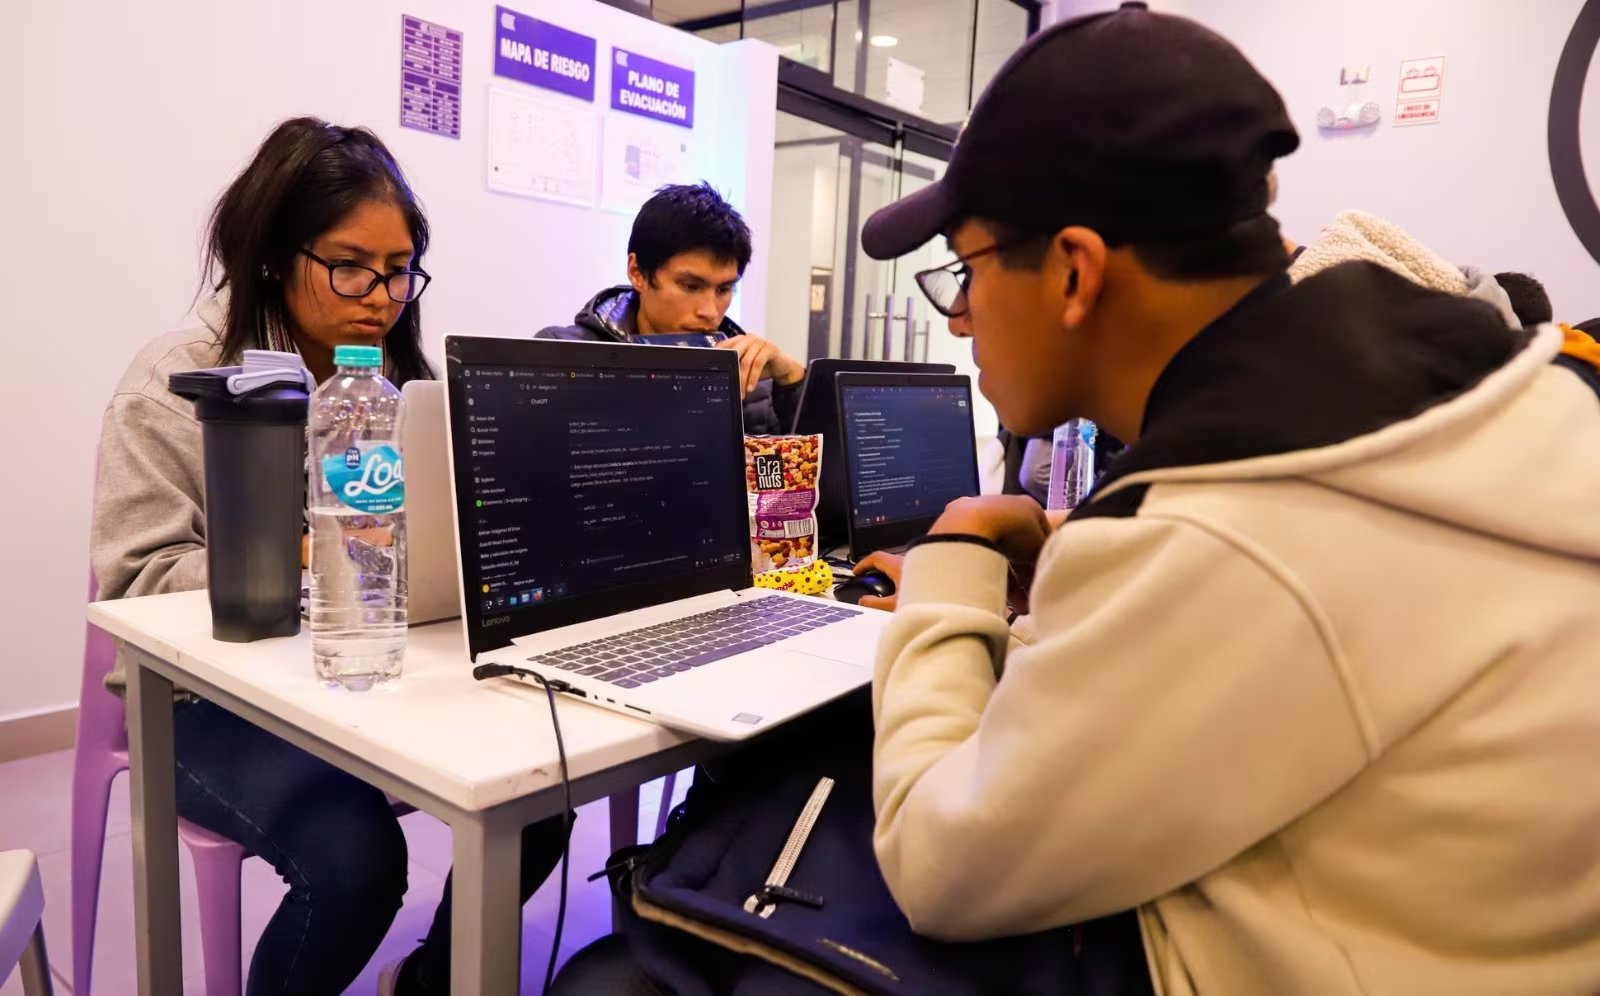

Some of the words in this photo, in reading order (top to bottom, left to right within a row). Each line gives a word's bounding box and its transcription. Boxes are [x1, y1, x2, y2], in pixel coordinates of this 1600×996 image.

[501, 37, 532, 65] MAPA
[534, 47, 549, 70] DE
[550, 53, 590, 83] RIESGO
[628, 70, 663, 94] PLANO
[665, 80, 680, 99] DE
[620, 89, 686, 120] EVACUACIÓN
[756, 456, 781, 476] Gra
[758, 474, 782, 489] nuts
[481, 615, 511, 628] Lenovo
